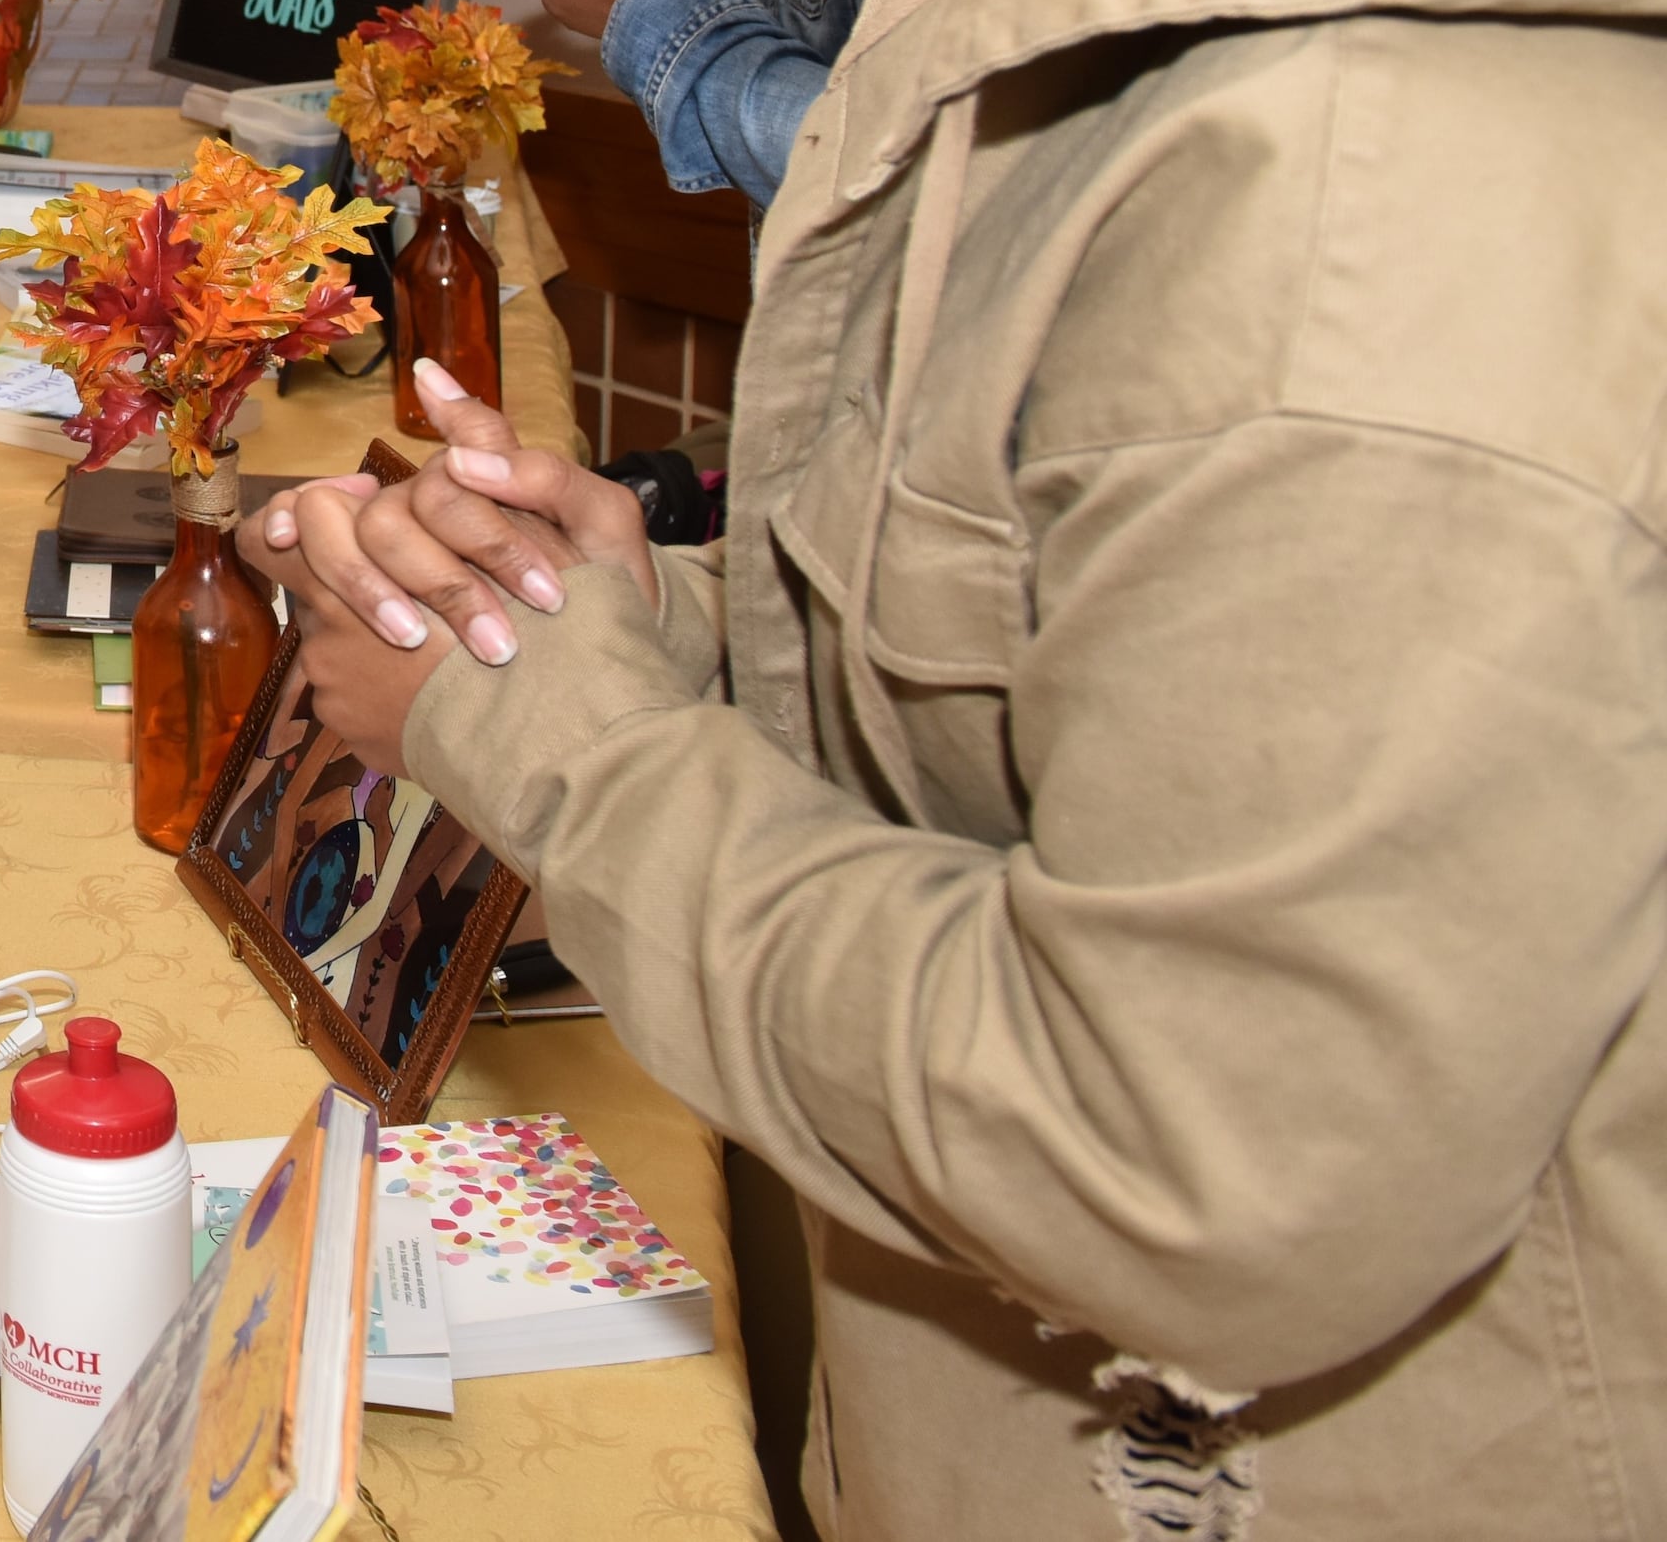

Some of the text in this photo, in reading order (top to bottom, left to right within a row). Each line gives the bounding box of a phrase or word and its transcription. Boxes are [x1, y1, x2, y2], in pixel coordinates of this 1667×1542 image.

[2, 371, 67, 403] aking
[7, 1324, 18, 1347] 4
[27, 1334, 101, 1375] MCH
[9, 1352, 102, 1395] Collaborative
